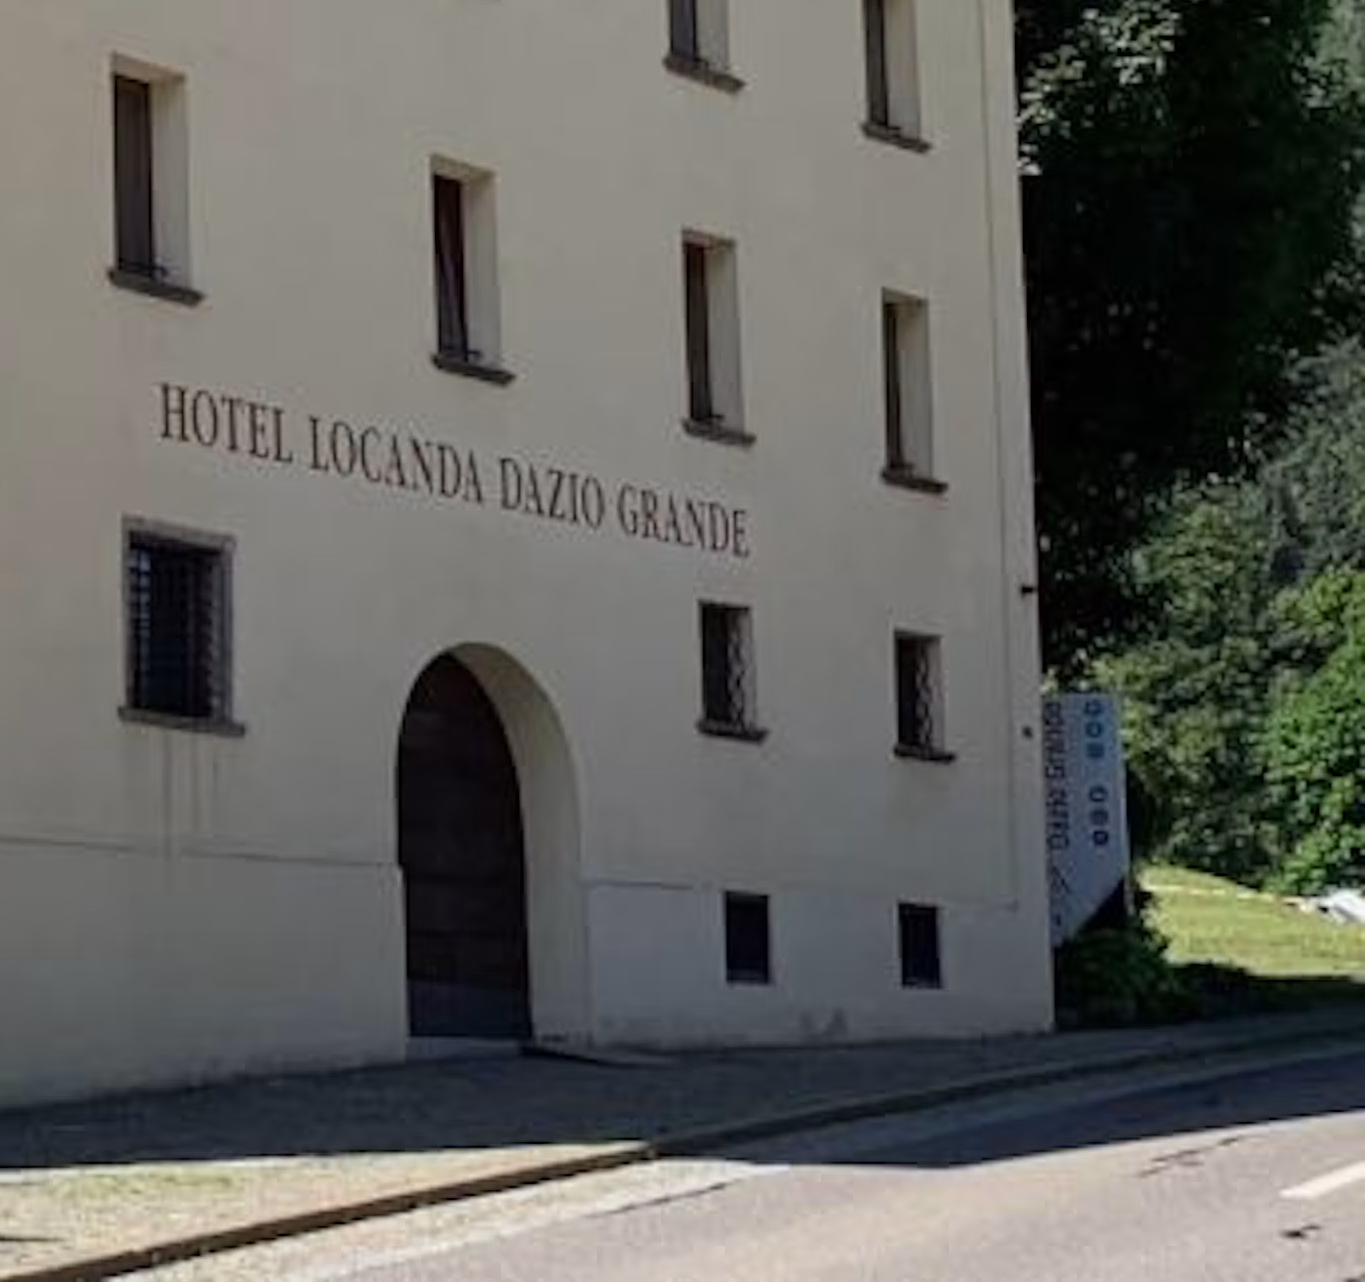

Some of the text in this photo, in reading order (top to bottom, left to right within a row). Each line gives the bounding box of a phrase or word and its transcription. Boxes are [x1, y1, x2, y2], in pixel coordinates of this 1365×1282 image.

[159, 382, 751, 560] HOTEL LOCANDA DAZIO GRANDE
